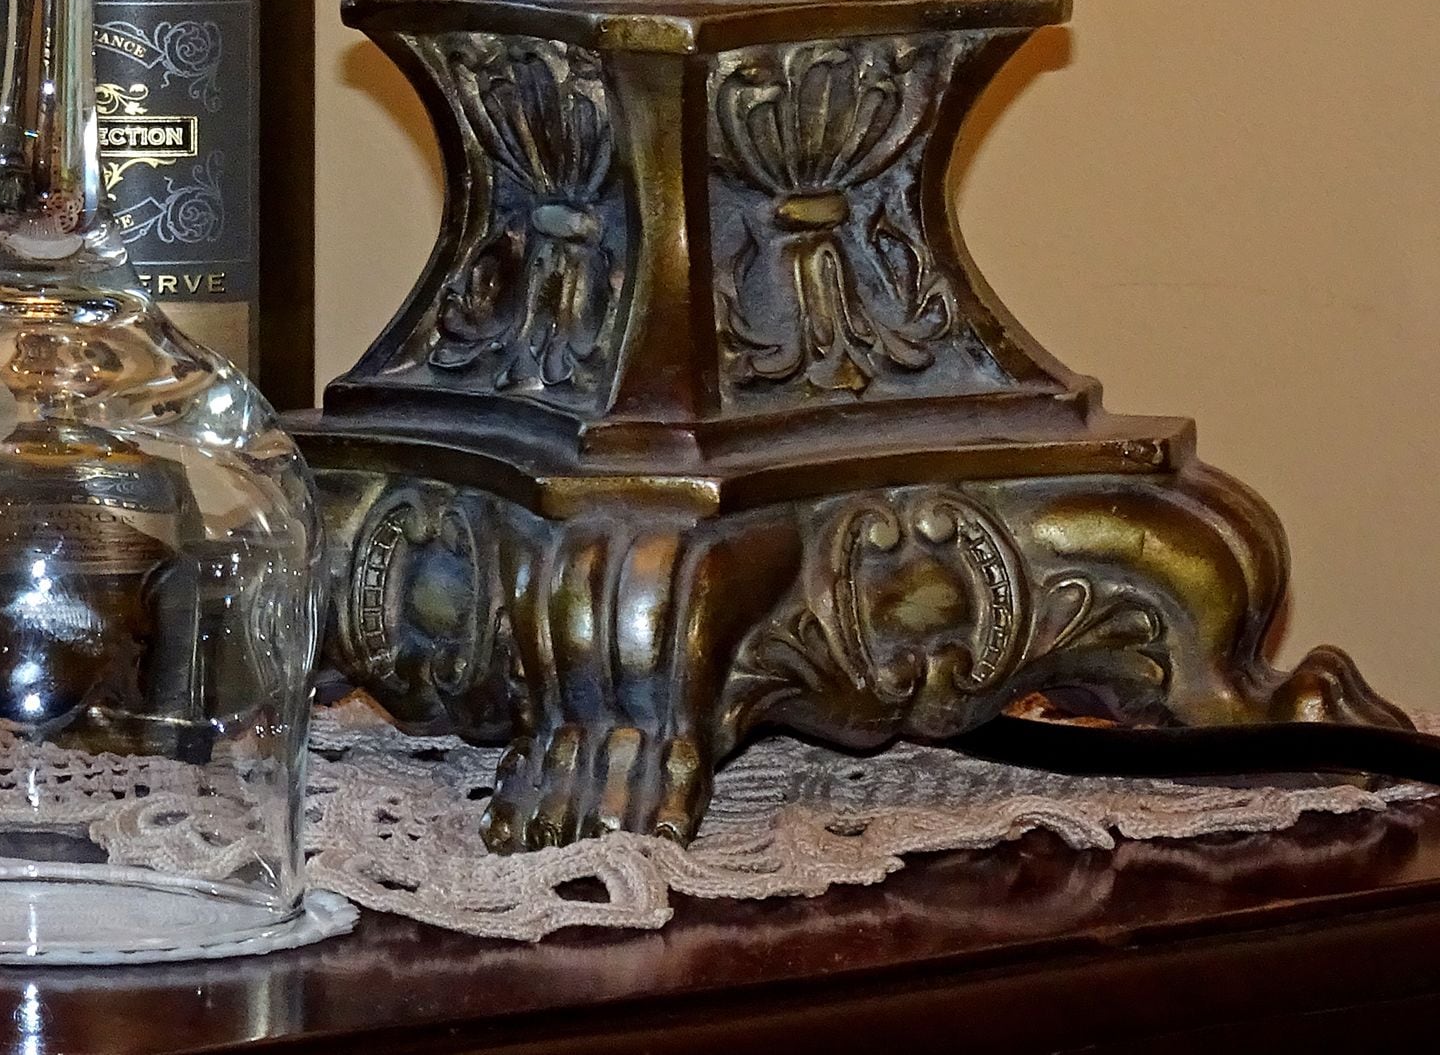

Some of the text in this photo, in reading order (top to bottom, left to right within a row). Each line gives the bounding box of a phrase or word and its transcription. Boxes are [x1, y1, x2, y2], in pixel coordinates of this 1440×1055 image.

[93, 30, 147, 58] ANCE
[98, 127, 183, 146] ECTION
[138, 272, 225, 294] ERVE
